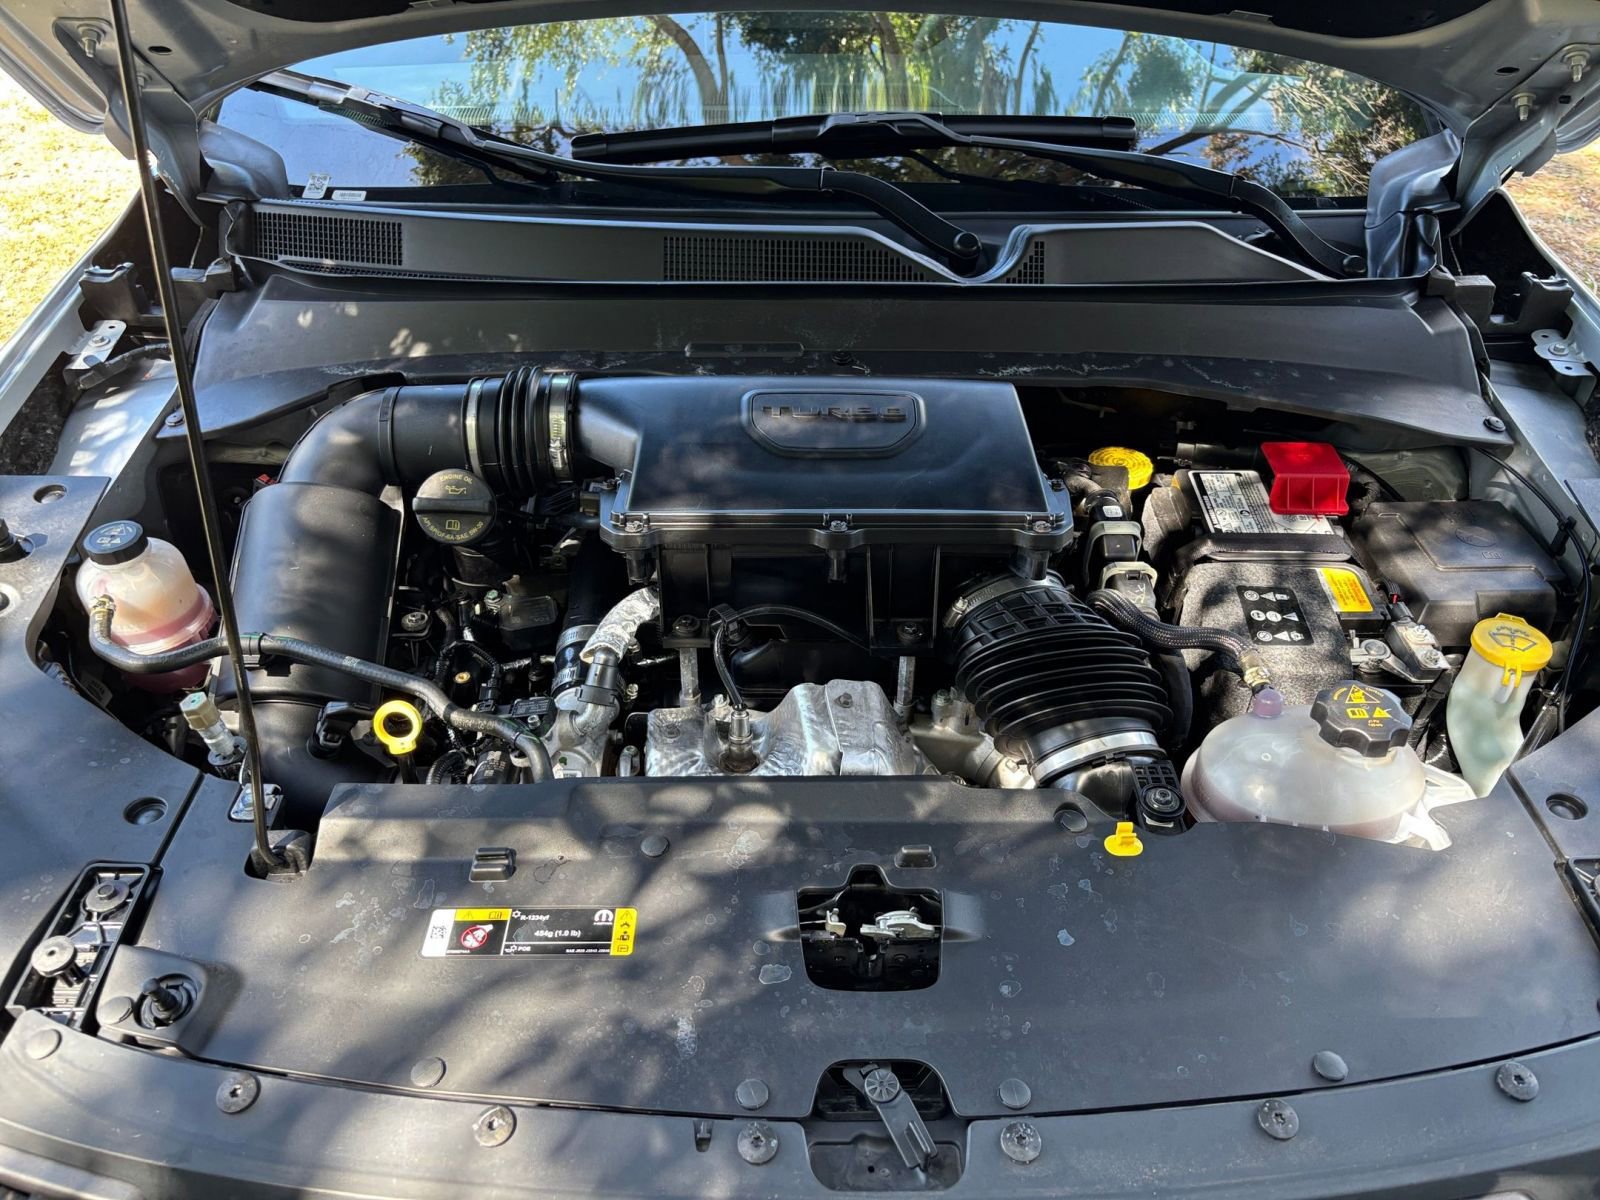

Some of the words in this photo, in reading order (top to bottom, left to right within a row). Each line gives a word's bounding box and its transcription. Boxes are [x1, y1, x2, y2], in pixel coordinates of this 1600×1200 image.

[463, 475, 473, 485] OIL
[422, 517, 432, 526] API
[555, 929, 569, 937] (1.0
[570, 929, 581, 937] lb)
